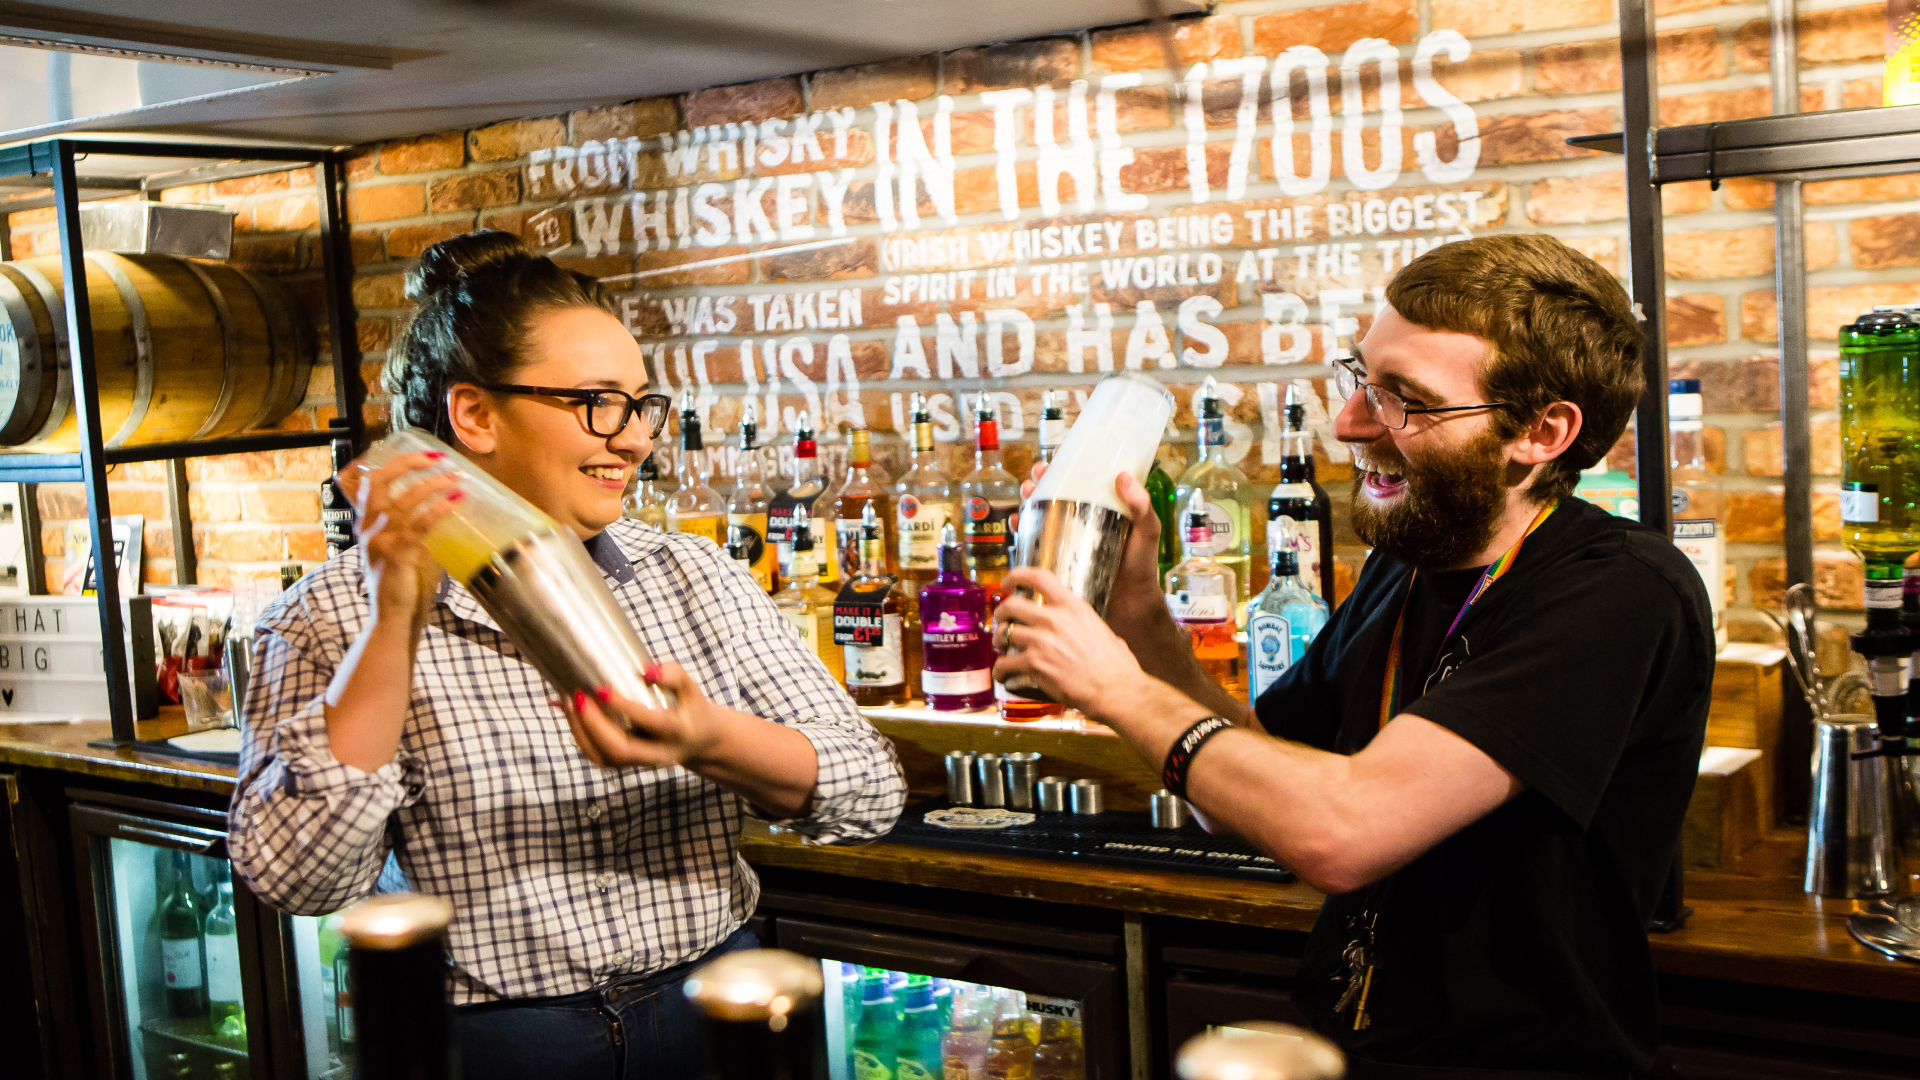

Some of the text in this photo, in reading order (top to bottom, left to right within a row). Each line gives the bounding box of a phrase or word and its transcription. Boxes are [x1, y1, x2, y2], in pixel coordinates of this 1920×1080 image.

[529, 106, 856, 194] FROM WHISKY
[872, 29, 1482, 232] IN THE 1700S
[534, 167, 855, 259] TO WHISKEY
[979, 221, 1124, 263] WHISKEY
[1135, 211, 1234, 250] BEING
[1244, 205, 1314, 242] THE
[1327, 190, 1483, 237] BIGGEST
[883, 269, 978, 305] SPIRIT
[985, 267, 1018, 298] IN
[1029, 262, 1090, 295] THE
[1100, 253, 1223, 290] WORLD
[1236, 248, 1279, 283] AT
[1293, 243, 1363, 278] THE
[664, 295, 738, 335] WAS
[748, 289, 863, 332] TAKEN
[891, 308, 1036, 379] AND
[1066, 295, 1230, 373] HAS
[740, 334, 866, 442] USA
[835, 606, 881, 616] MAKE IT A
[835, 615, 882, 627] DOUBLE
[835, 632, 854, 641] FROM
[0, 645, 47, 670] BIG
[1104, 842, 1171, 853] CRAFTED
[1174, 848, 1204, 856] THE
[1206, 851, 1252, 860] CORK
[1026, 1000, 1076, 1017] HUSKY
